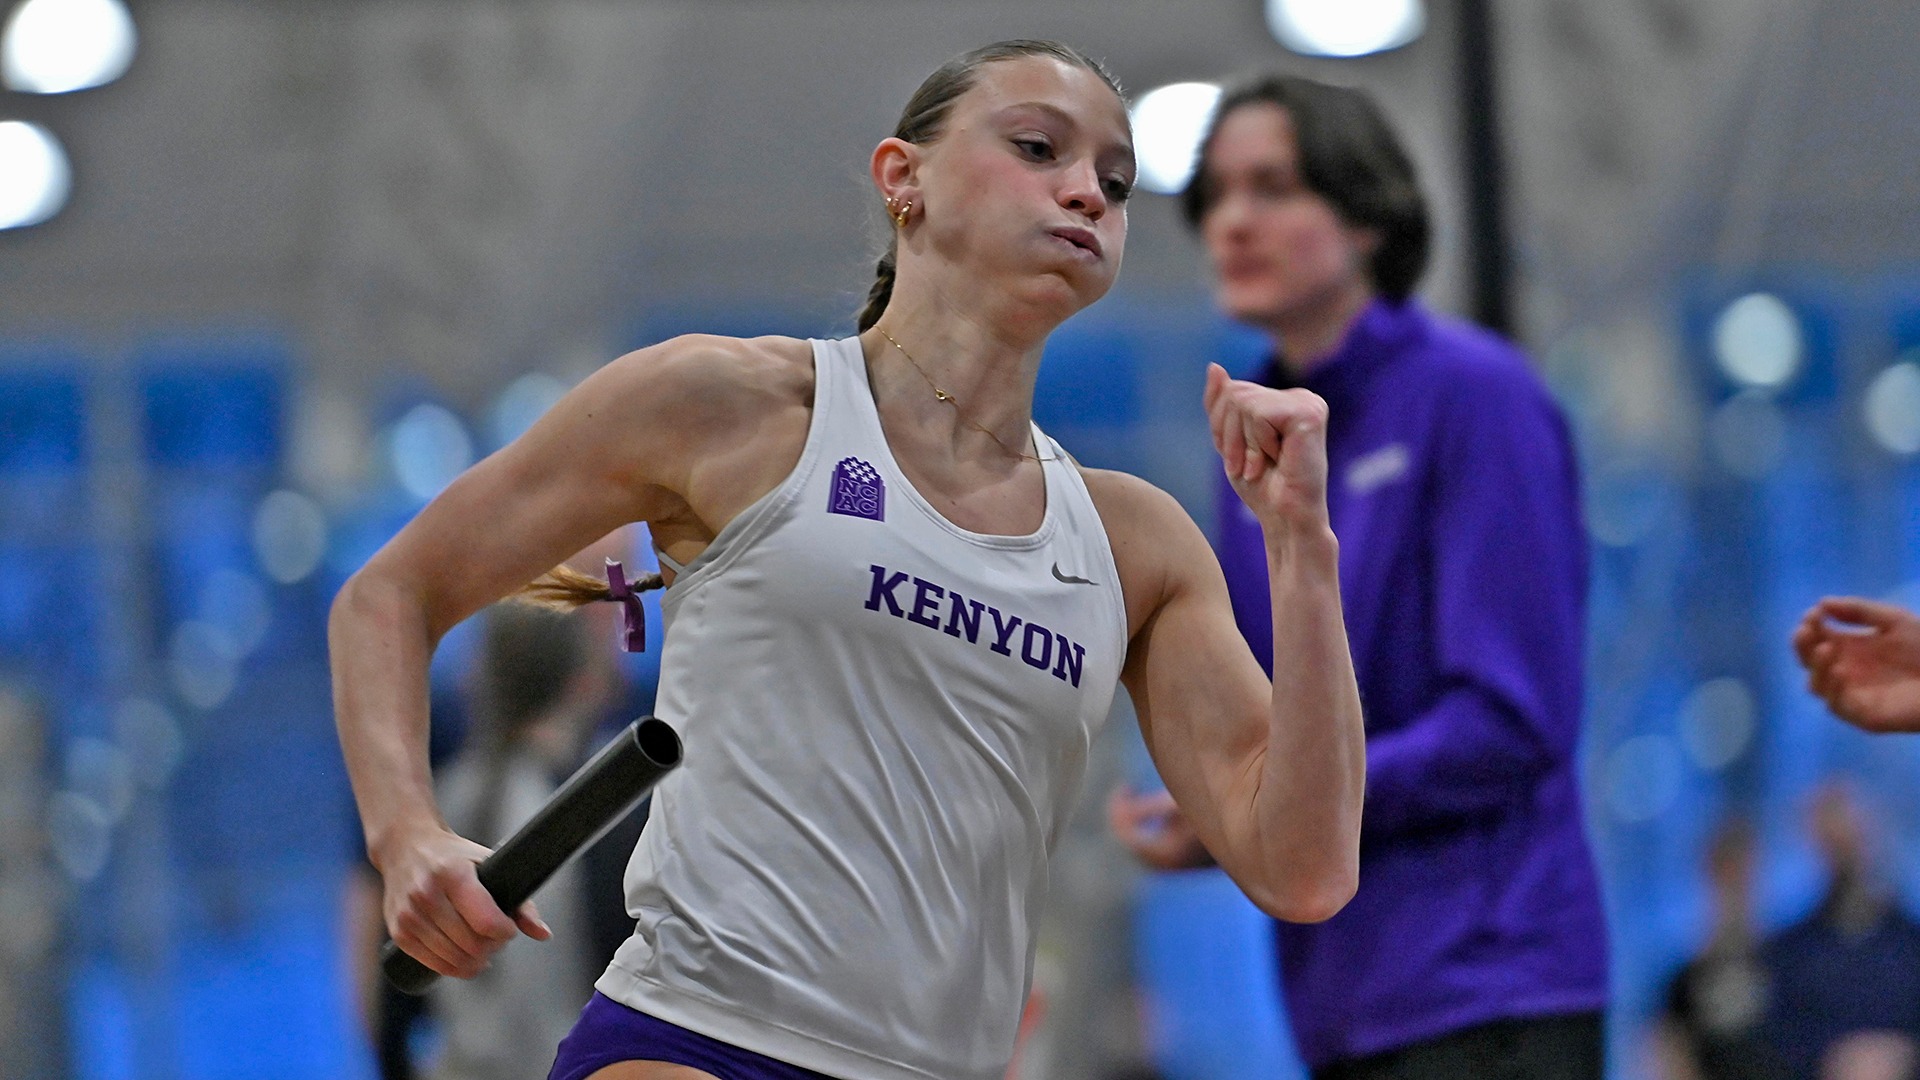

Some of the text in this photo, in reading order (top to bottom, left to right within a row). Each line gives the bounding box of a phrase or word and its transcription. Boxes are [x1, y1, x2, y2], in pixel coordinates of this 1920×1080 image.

[838, 477, 878, 500] NC
[836, 494, 878, 515] AC
[864, 564, 1086, 689] KENYON
